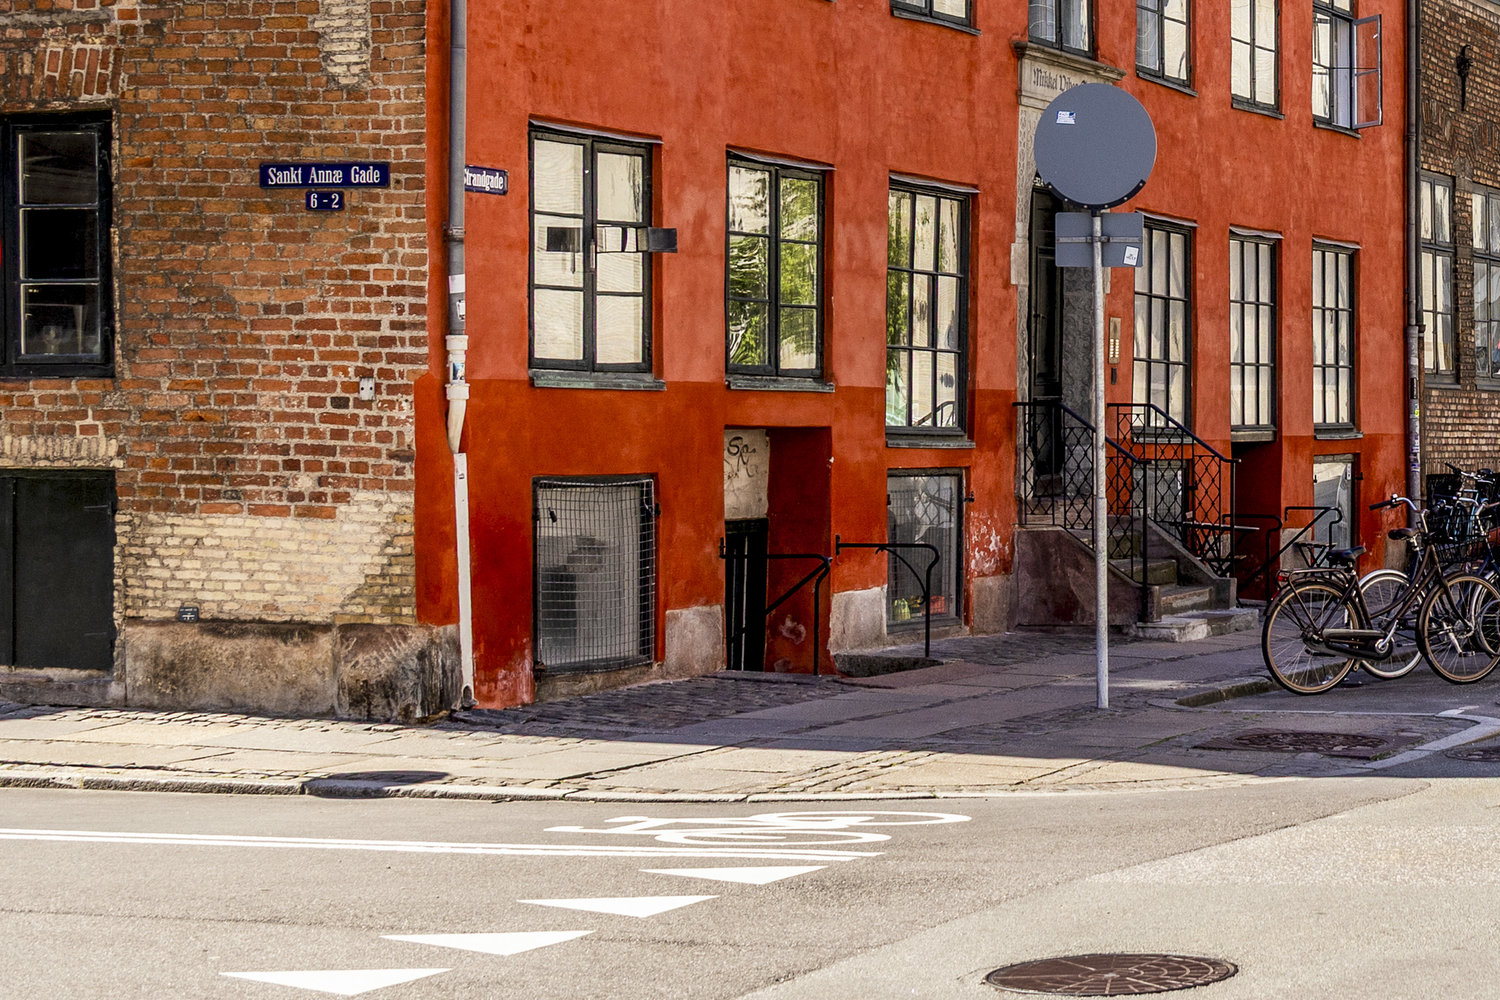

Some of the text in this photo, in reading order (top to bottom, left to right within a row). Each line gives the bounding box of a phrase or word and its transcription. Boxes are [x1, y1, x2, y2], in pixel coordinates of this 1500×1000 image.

[268, 165, 380, 185] Sankt Annæ Gade
[310, 193, 318, 208] 6
[331, 193, 339, 208] 2
